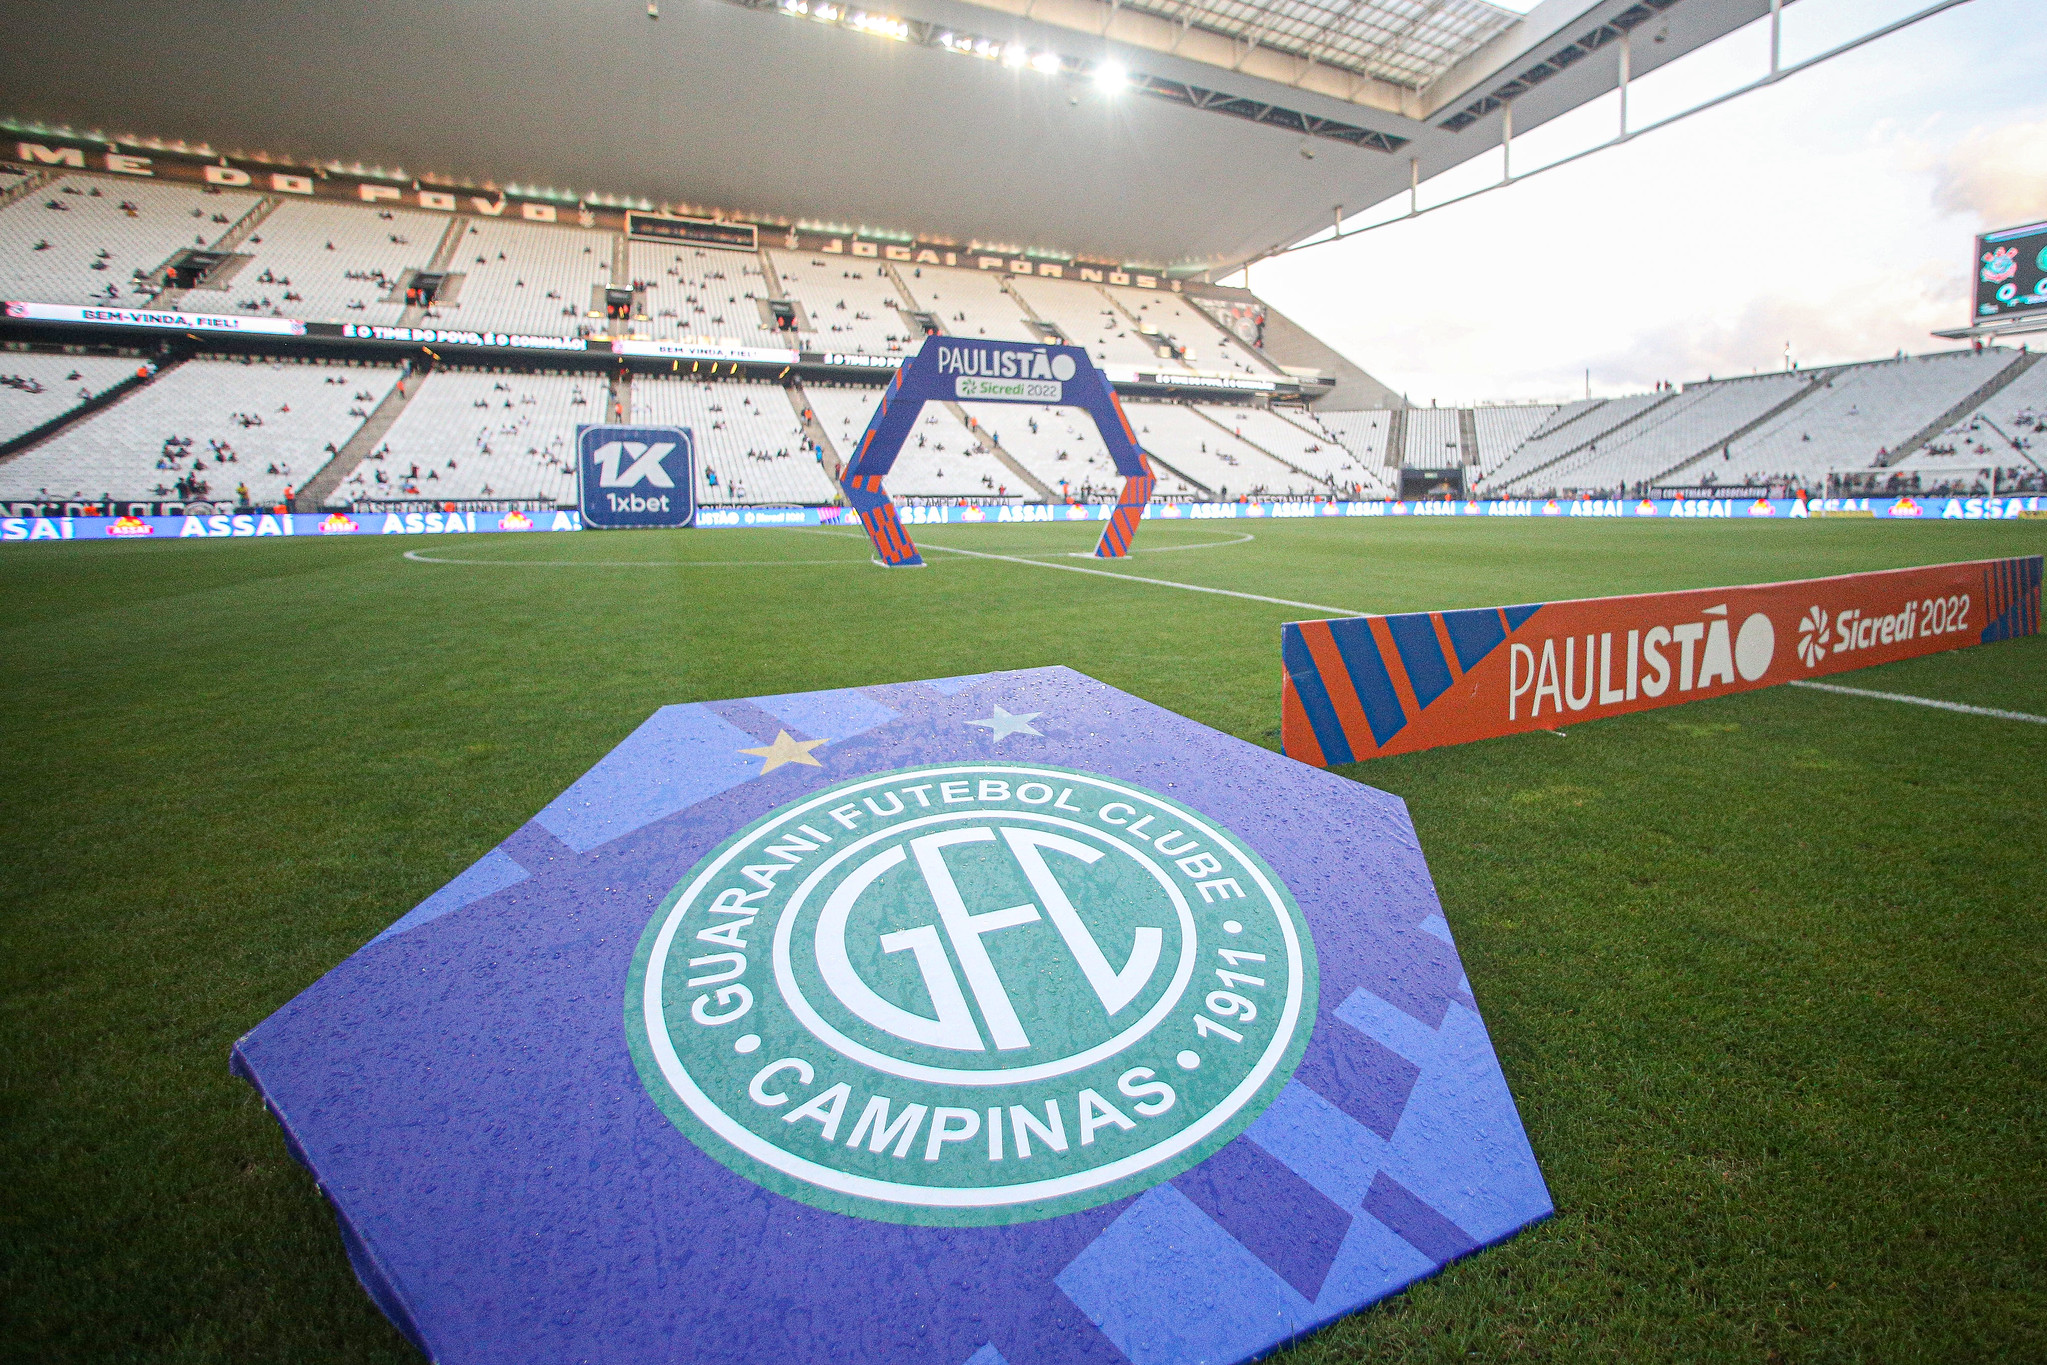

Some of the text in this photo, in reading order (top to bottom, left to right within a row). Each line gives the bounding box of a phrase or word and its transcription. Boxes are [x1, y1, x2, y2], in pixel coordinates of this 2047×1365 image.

[205, 164, 314, 195] DO
[358, 183, 557, 223] POVO
[821, 238, 957, 266] JOGAI
[978, 255, 1063, 278] POR
[196, 317, 240, 329] FIEL!
[939, 346, 1076, 382] PAULISTÃO
[980, 381, 1057, 397] Sicredi 2022
[606, 492, 670, 512] 1xbet
[0, 516, 74, 540] SSAÍ
[1509, 593, 1971, 721] PAULISTÃO Sicredi 2022
[686, 778, 1247, 1027] GUARANI FUTEBOL CLUBE
[1197, 947, 1267, 1043] 1911
[749, 1056, 1177, 1162] CAMPINAS
